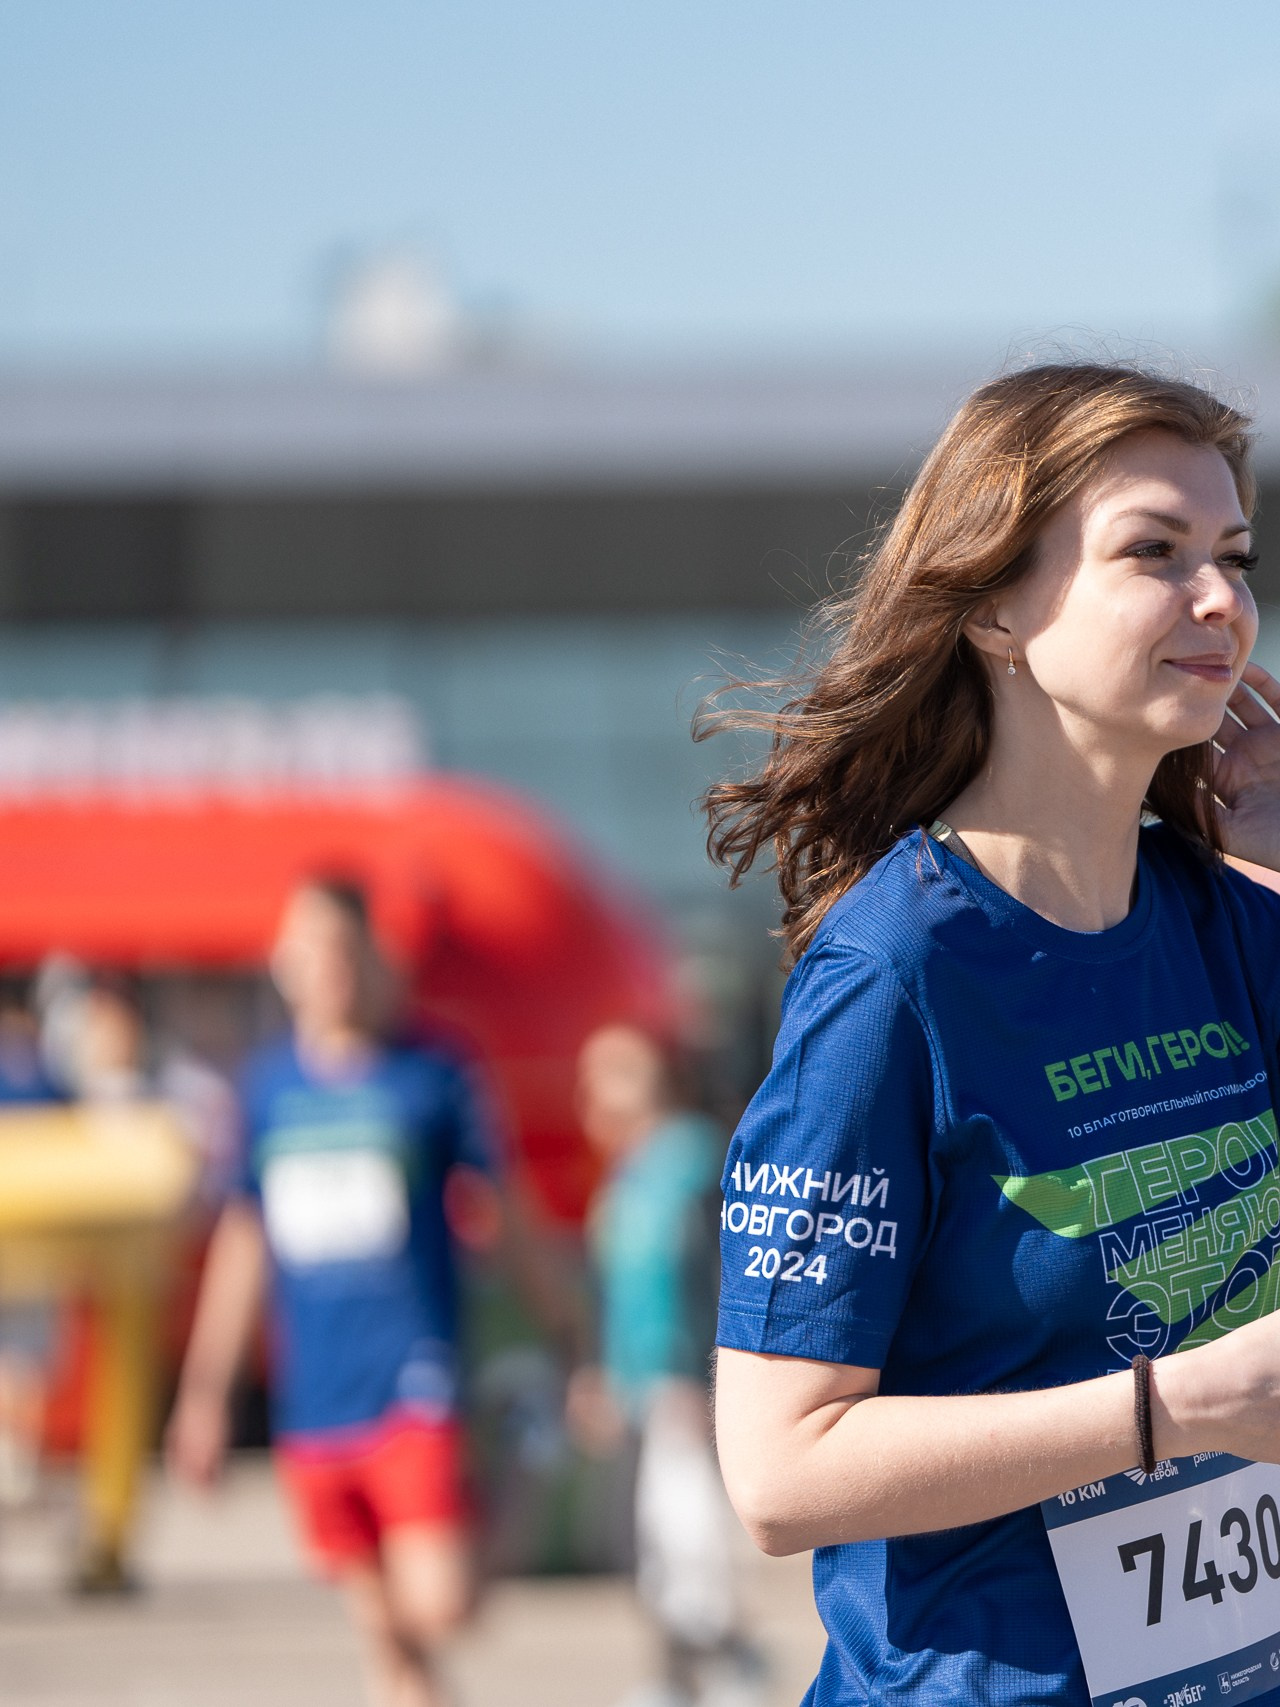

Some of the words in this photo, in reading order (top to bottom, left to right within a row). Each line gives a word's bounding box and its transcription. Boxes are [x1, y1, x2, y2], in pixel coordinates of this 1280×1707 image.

[1067, 1126, 1082, 1139] 10
[1084, 1090, 1204, 1134] БЛАГОТВОРИТЕЛЬНЫЙ
[744, 1246, 828, 1285] 2024
[1154, 1459, 1174, 1473] ЕГИ,
[1057, 1490, 1076, 1507] 10
[1079, 1481, 1106, 1502] КМ
